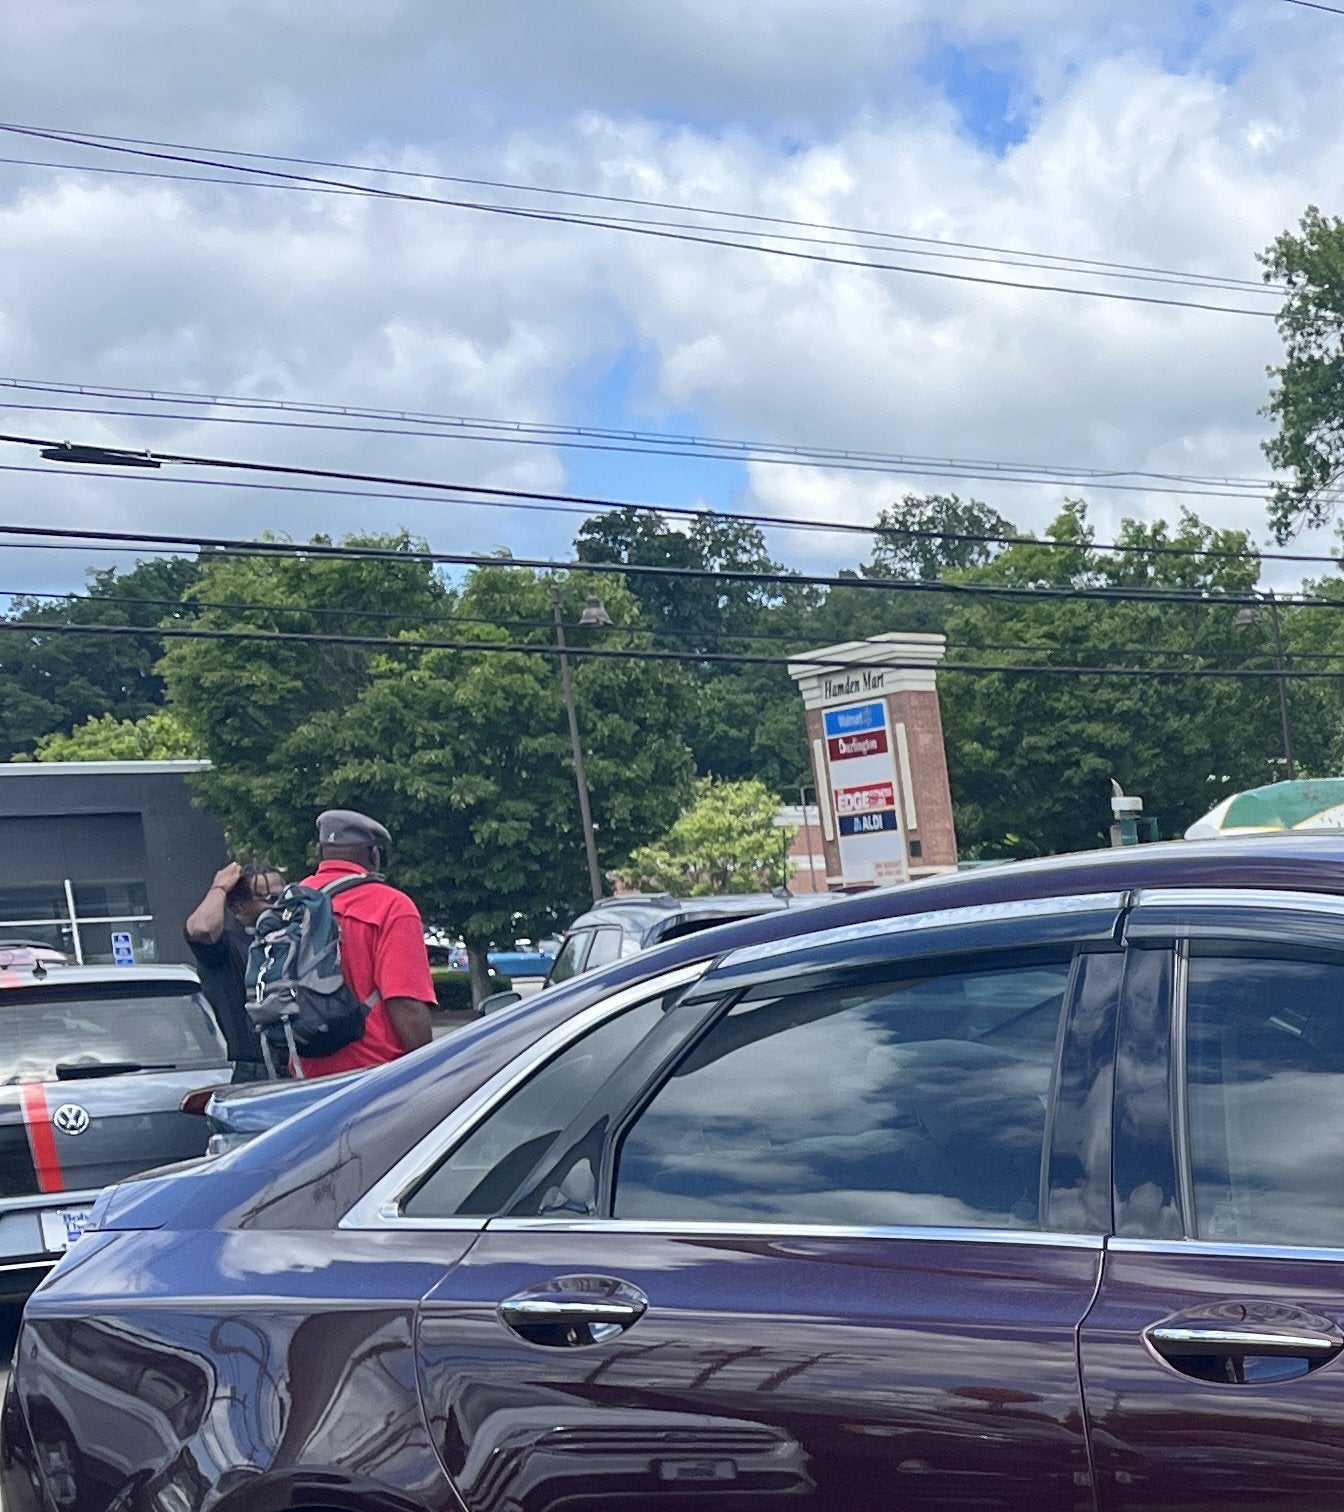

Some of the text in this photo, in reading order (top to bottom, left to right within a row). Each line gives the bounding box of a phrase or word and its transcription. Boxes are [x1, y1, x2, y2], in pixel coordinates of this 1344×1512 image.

[824, 671, 884, 699] Hamden Mart
[838, 791, 870, 812] EDGE
[862, 814, 884, 831] ALDI
